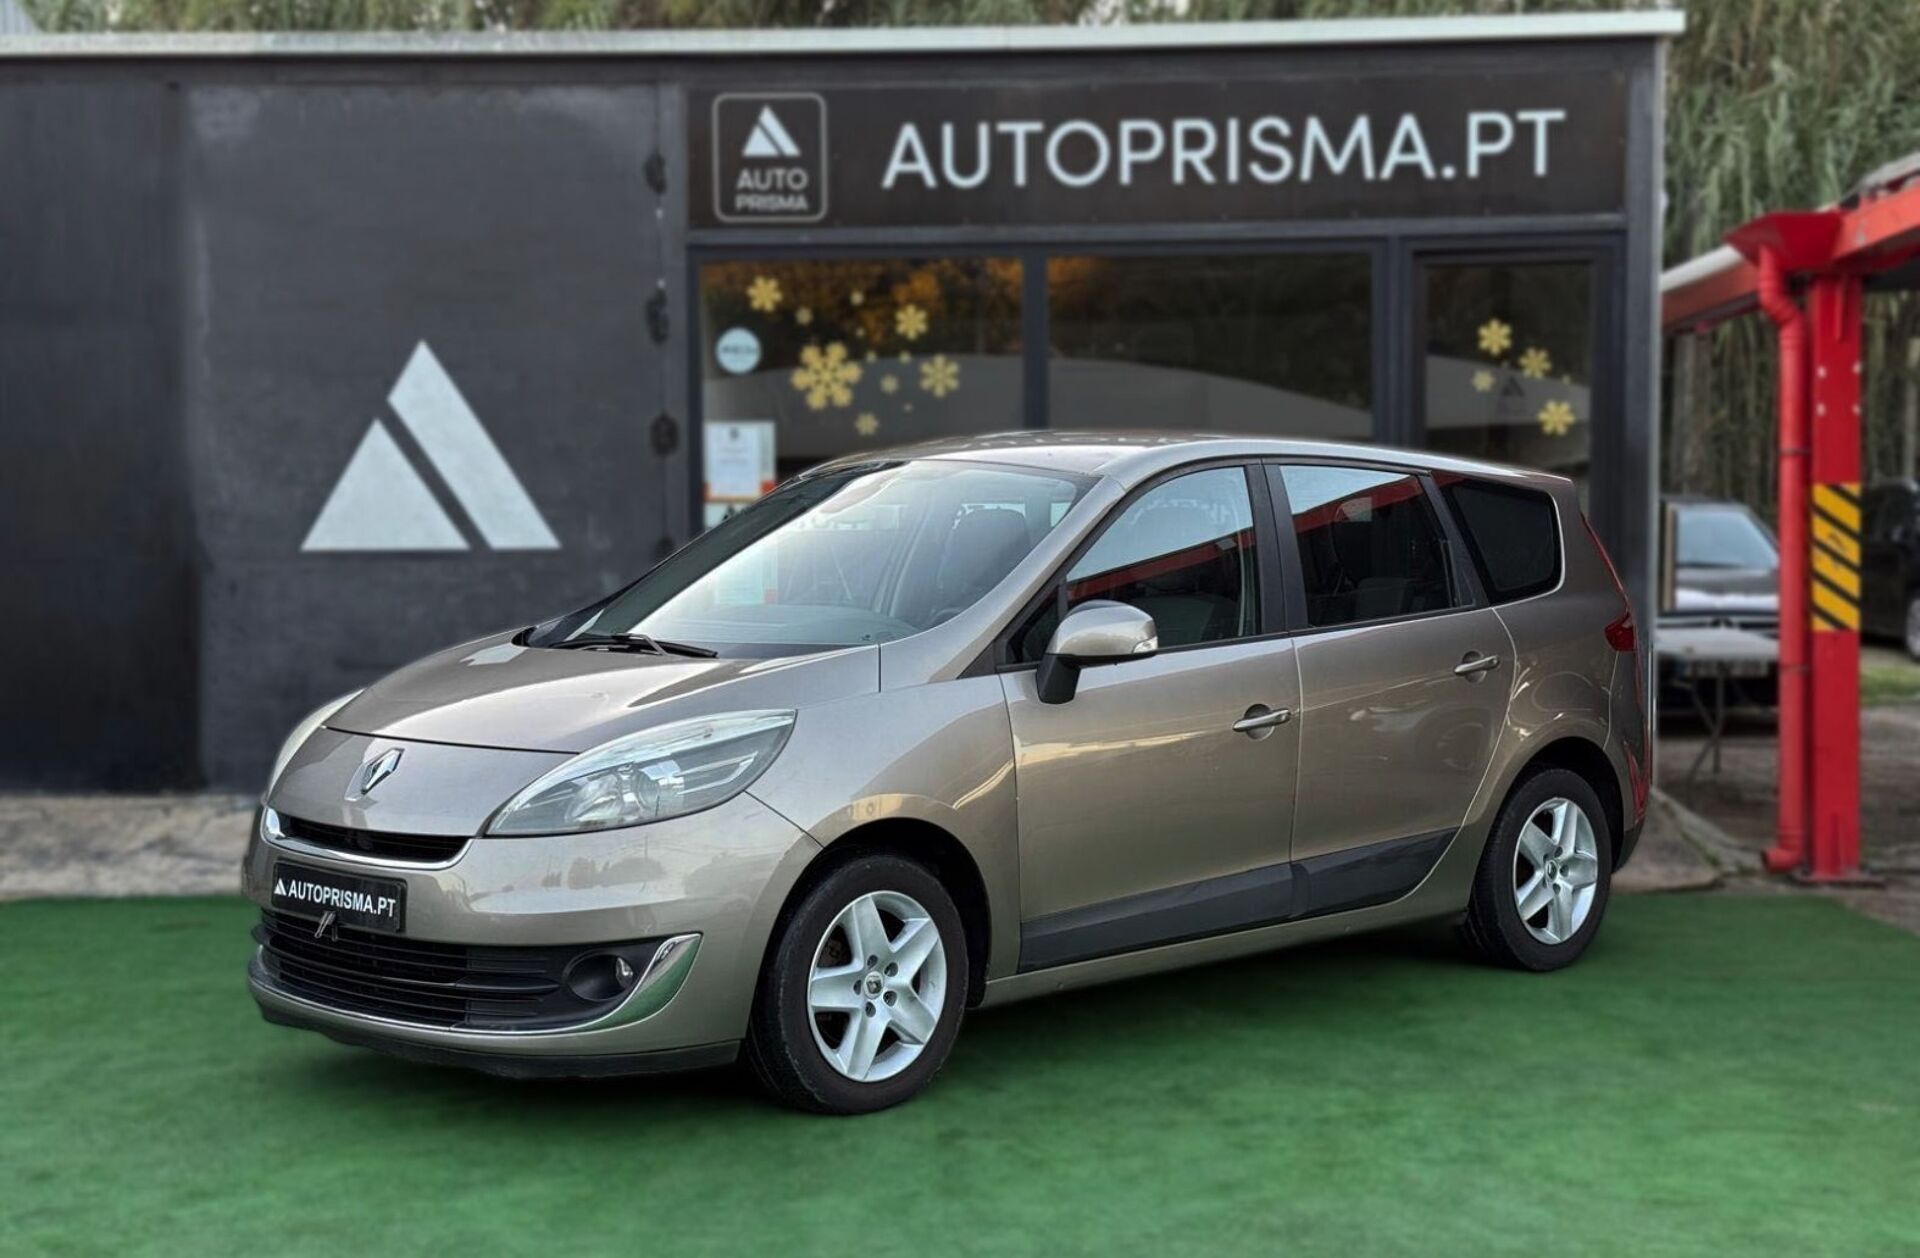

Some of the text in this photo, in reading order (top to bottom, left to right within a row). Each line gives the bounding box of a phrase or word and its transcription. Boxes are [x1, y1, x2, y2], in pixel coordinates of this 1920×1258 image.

[882, 109, 1567, 190] AUTOPRISMA.PT
[736, 167, 808, 191] AUTO
[735, 194, 808, 212] PRISMA
[287, 879, 396, 918] AUTOPRISMA.PT
